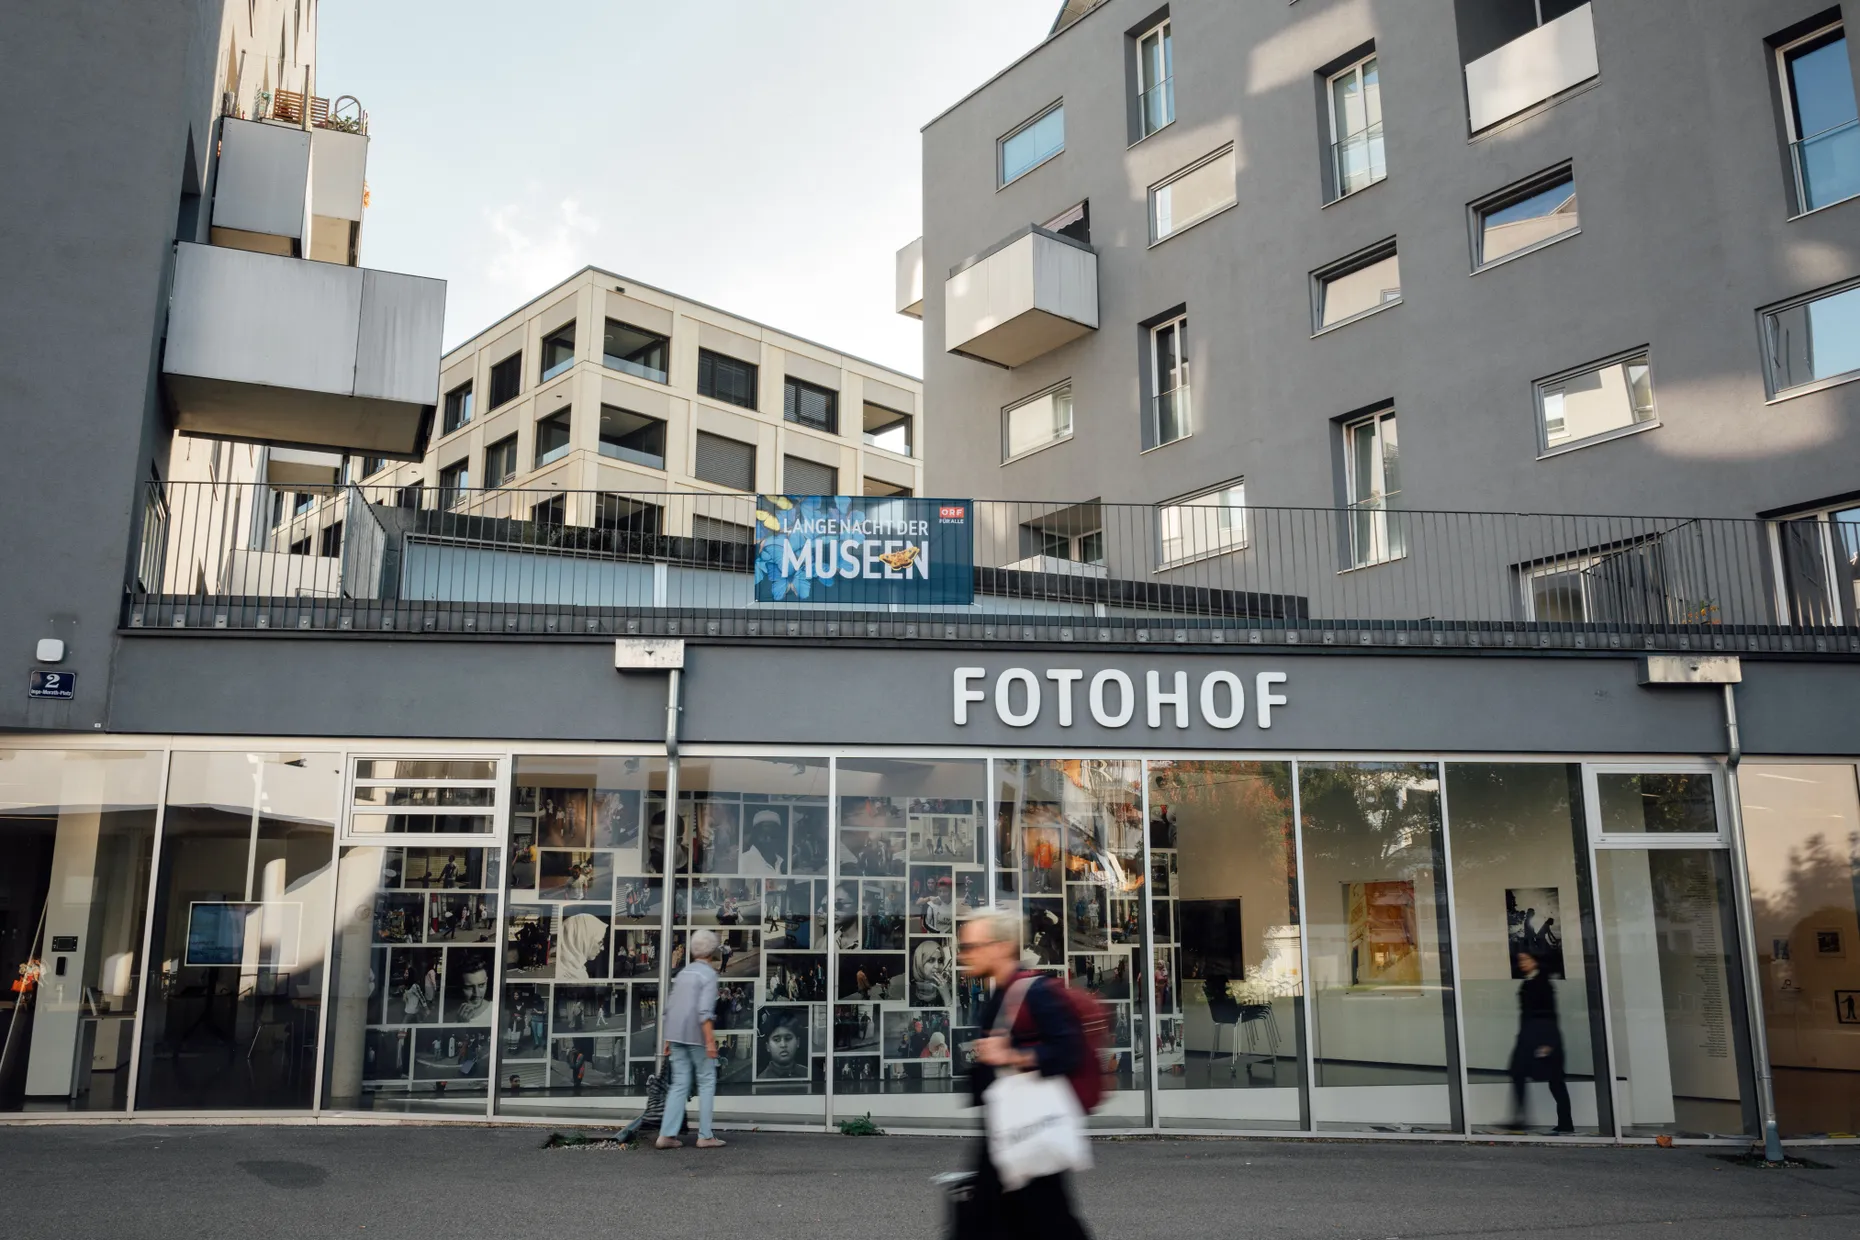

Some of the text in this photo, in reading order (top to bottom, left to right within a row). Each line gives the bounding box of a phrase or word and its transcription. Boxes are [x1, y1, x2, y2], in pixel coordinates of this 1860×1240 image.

[941, 508, 963, 516] ORF
[783, 518, 929, 536] LANGE NACHT DER
[781, 539, 929, 580] MUSEEN
[45, 673, 60, 688] 2
[953, 667, 1287, 729] FOTOHOF
